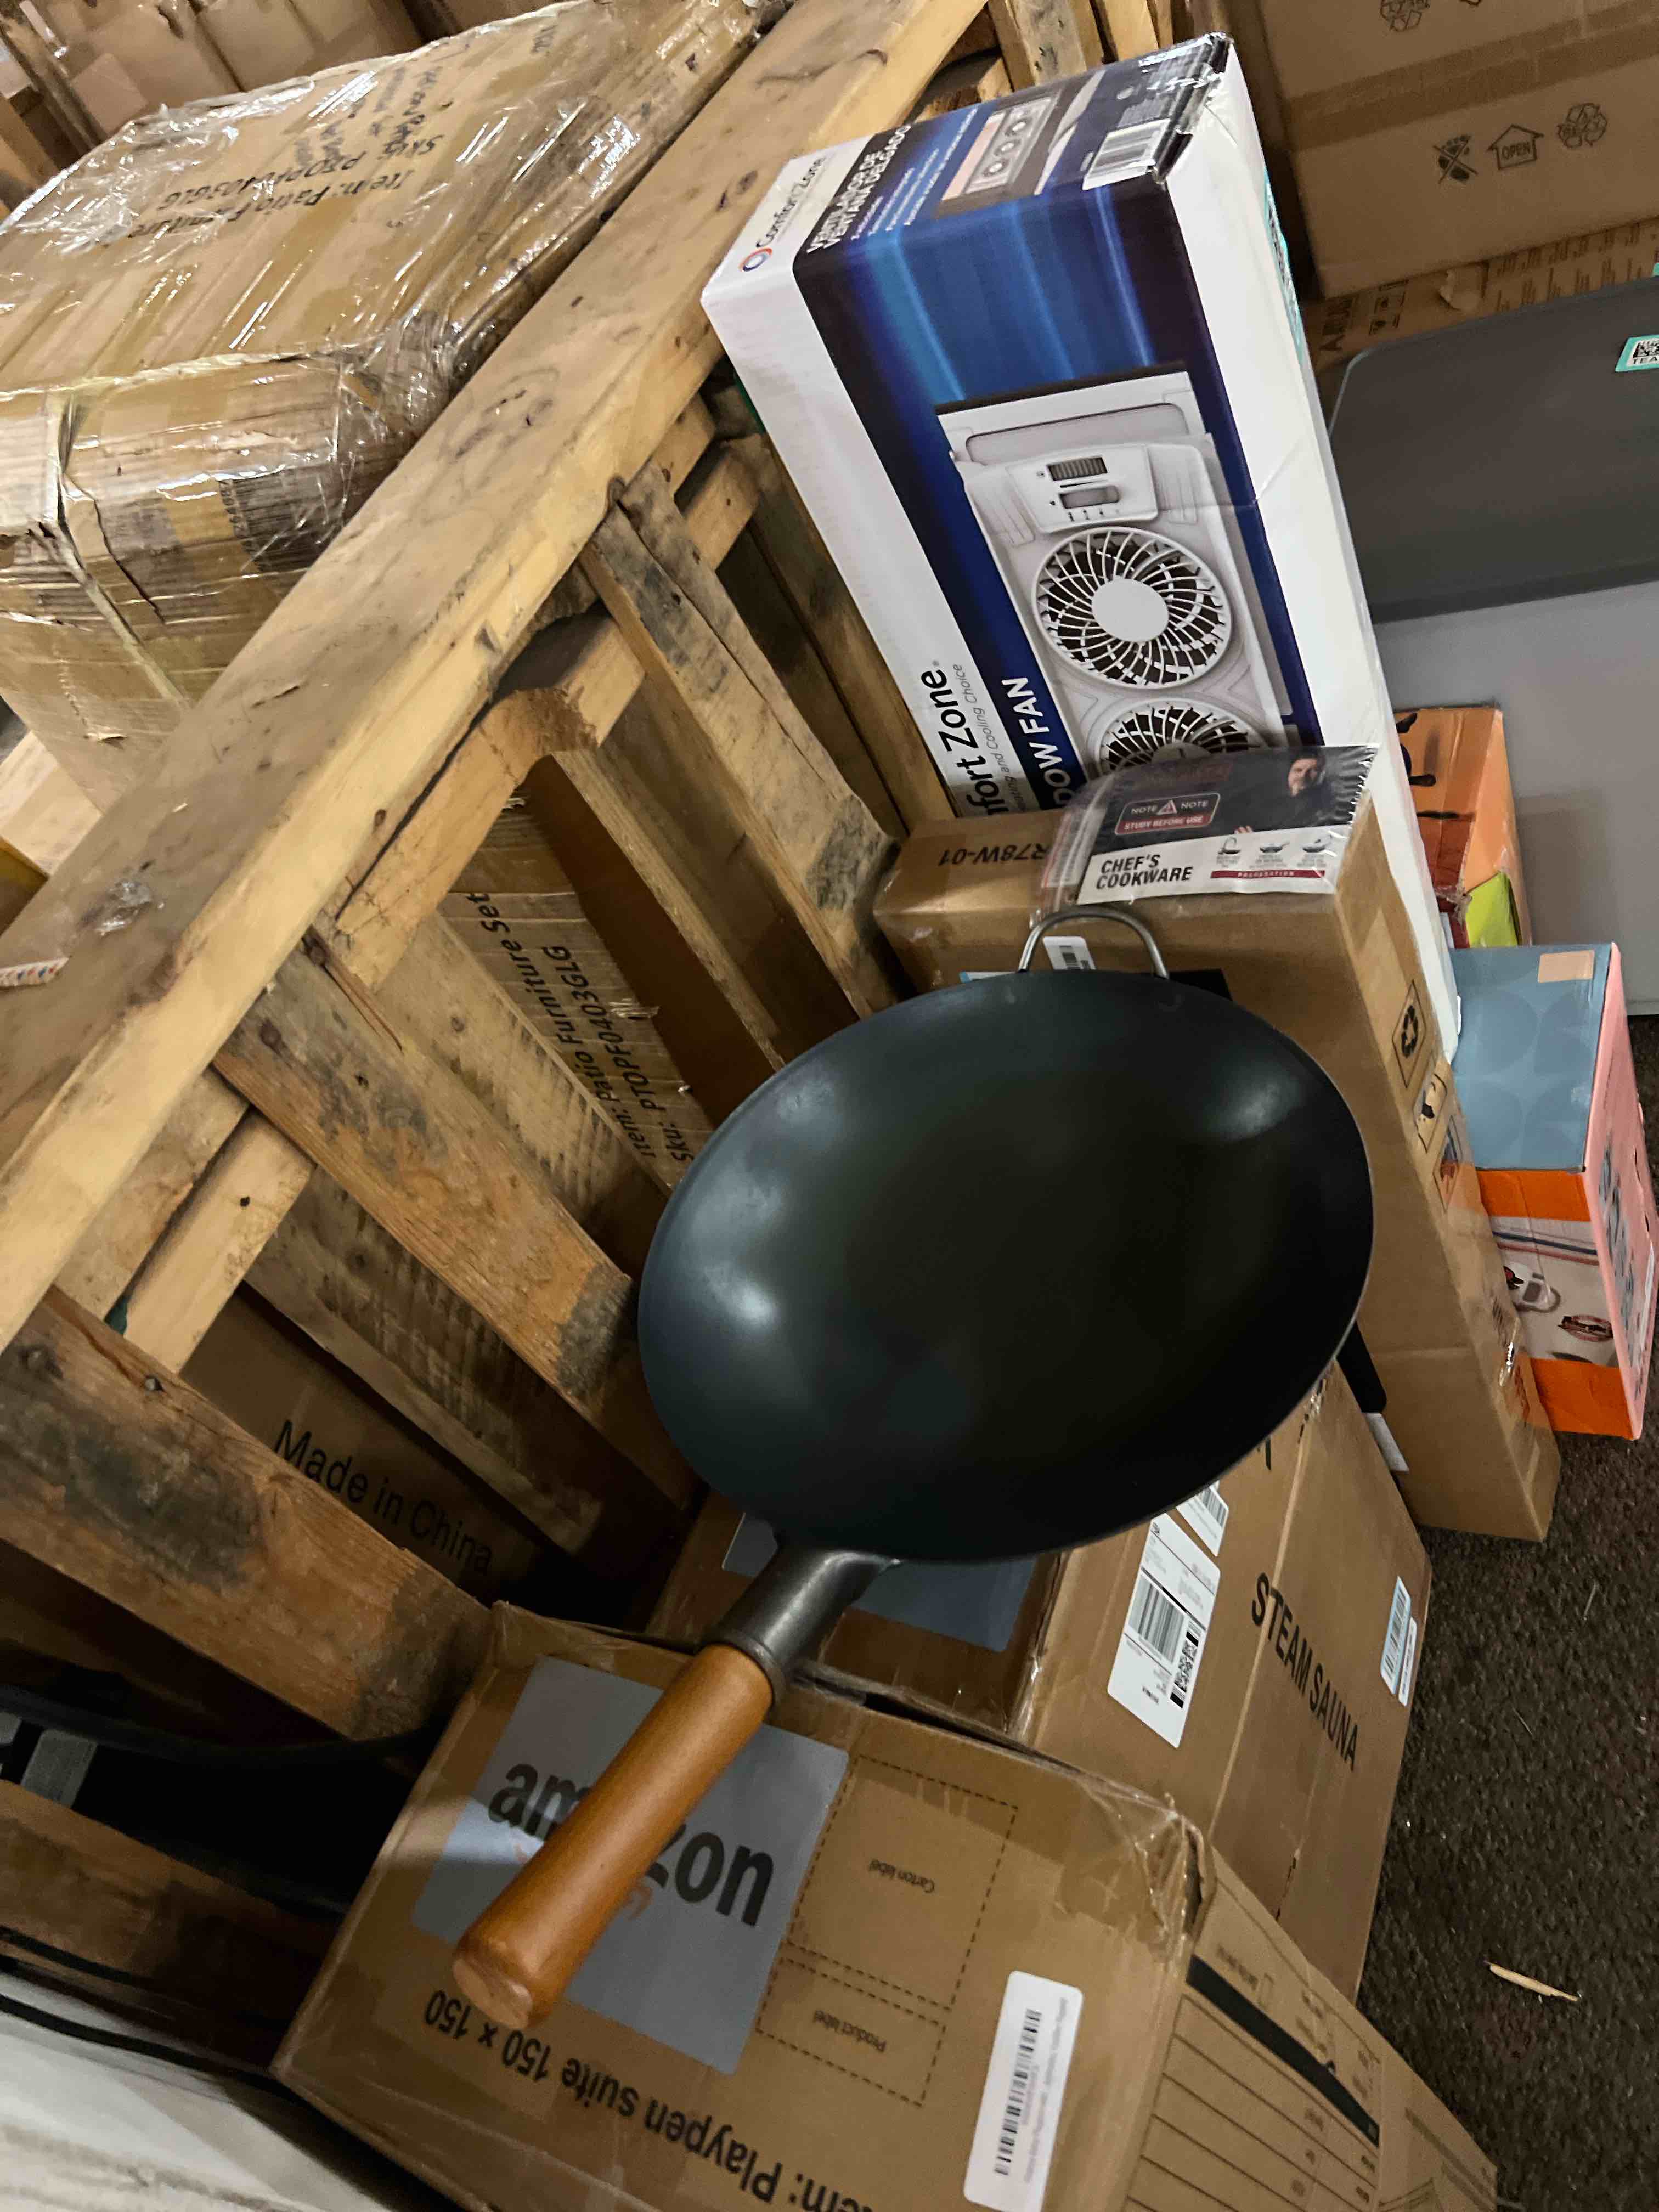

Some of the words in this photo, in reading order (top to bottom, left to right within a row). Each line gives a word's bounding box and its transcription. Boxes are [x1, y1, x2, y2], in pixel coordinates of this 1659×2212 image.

[1502, 142, 1531, 160] OPEN
[953, 663, 977, 704] Choice
[1001, 677, 1049, 734] FAN
[921, 669, 979, 753] Zone
[973, 707, 998, 752] Cooling
[957, 755, 1009, 816] fort
[991, 751, 1011, 774] and
[1131, 805, 1158, 815] NOTE
[1180, 800, 1209, 809] NOTE
[1185, 815, 1204, 824] USE
[1097, 866, 1194, 889] COOKWARE
[1101, 854, 1161, 873] CHEF'S
[466, 892, 511, 934] Set
[501, 939, 584, 1045] Furniture
[541, 945, 667, 1112] PTOPF0403GLG
[274, 1420, 370, 1504] Made
[373, 1476, 404, 1525] in
[410, 1499, 494, 1577] China
[1251, 1572, 1309, 1697] STEAM
[1308, 1662, 1359, 1773] SAUNA
[425, 1989, 469, 2040] 150
[478, 2021, 498, 2048] x
[501, 2028, 551, 2083] 150
[561, 2056, 639, 2119] suite
[645, 2098, 783, 2204] Playpen
